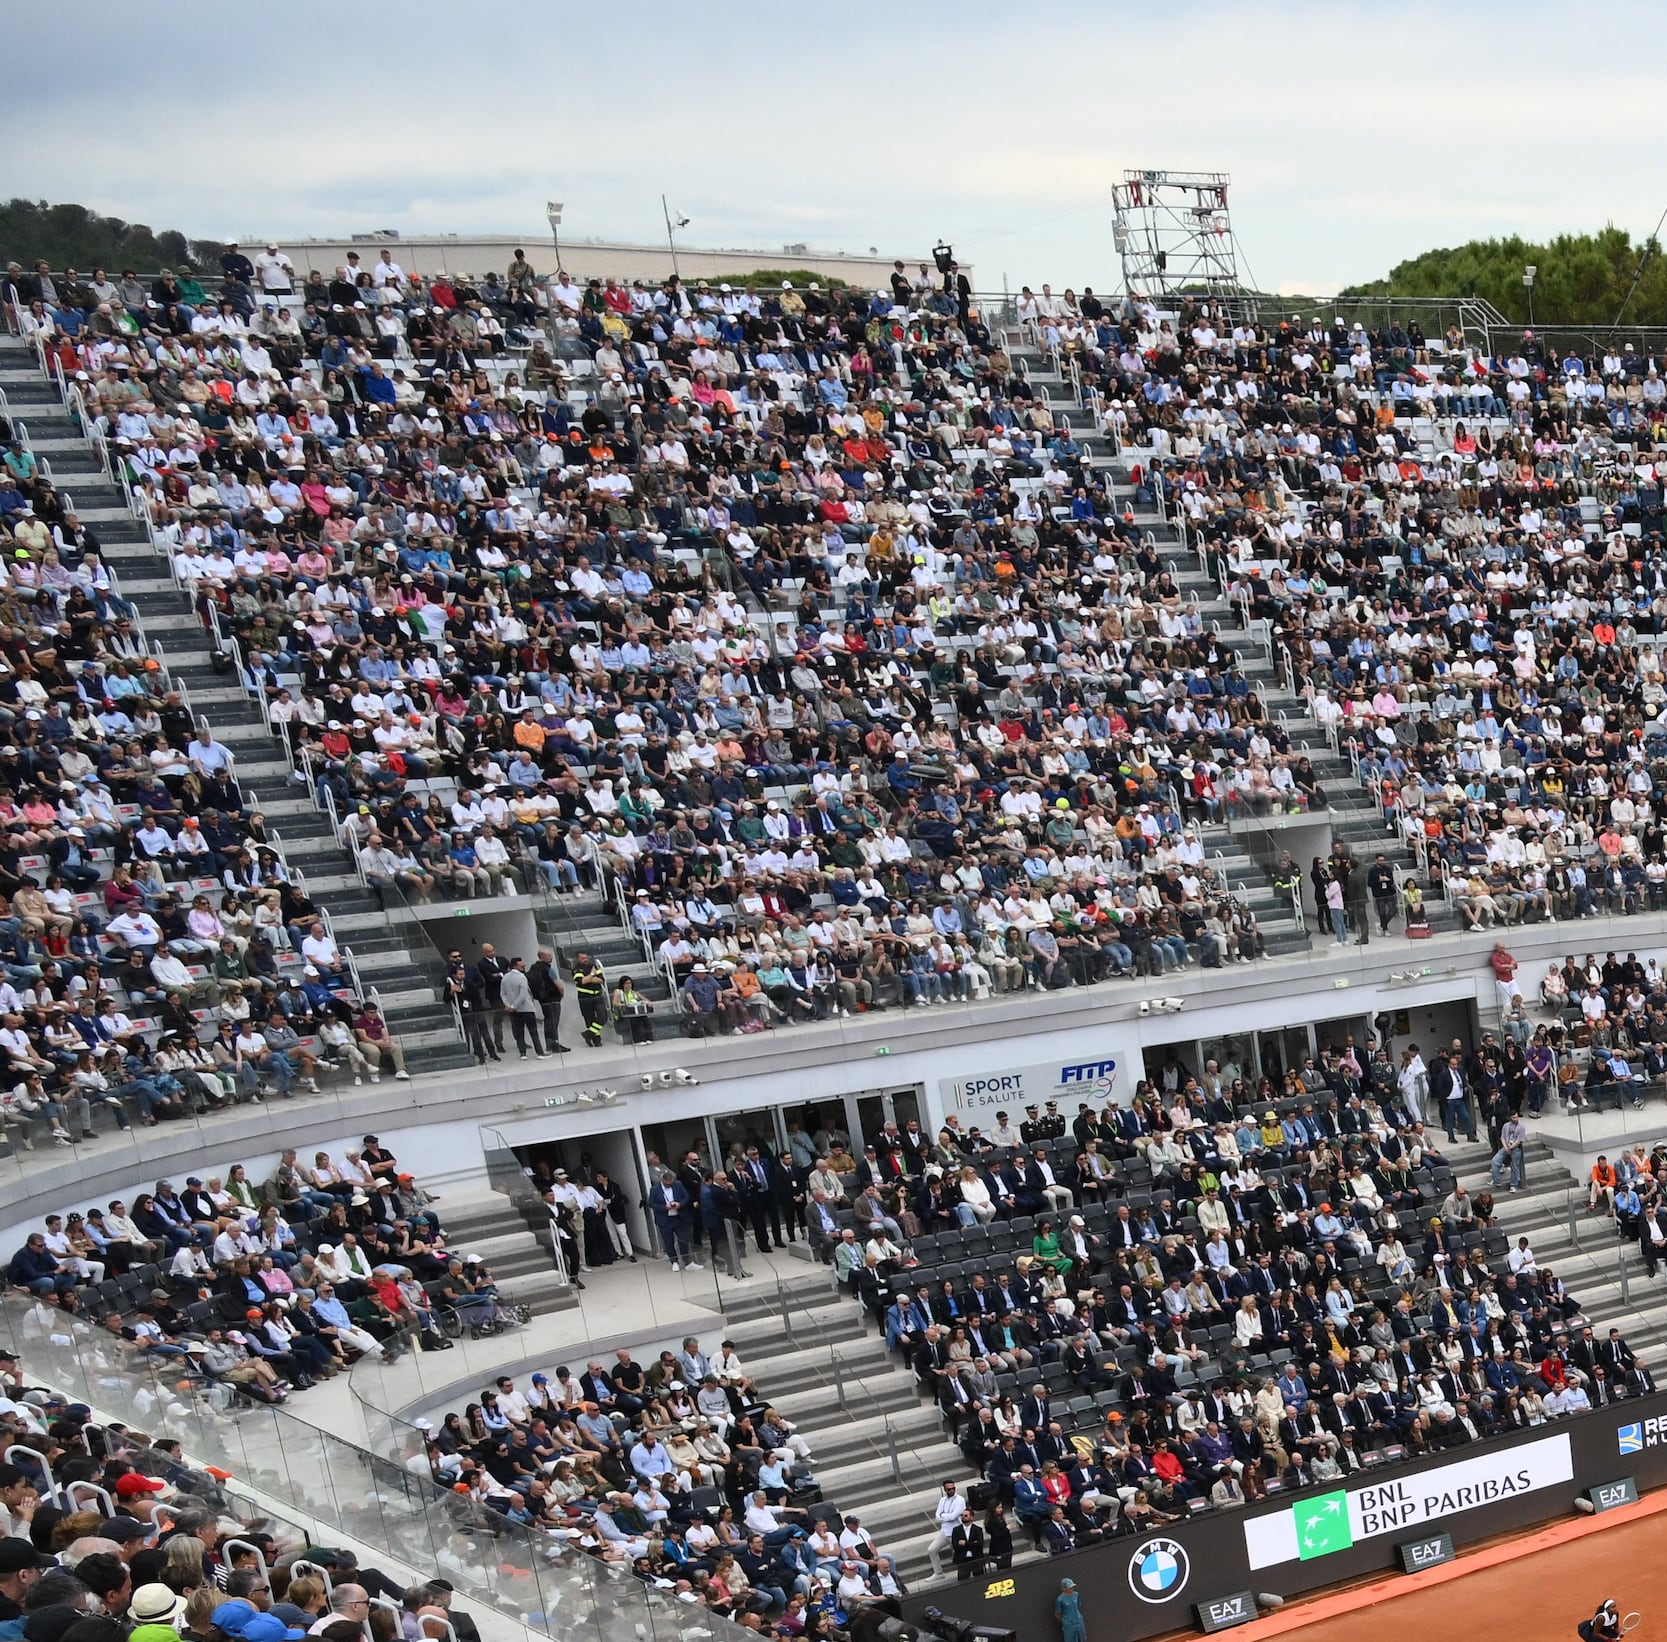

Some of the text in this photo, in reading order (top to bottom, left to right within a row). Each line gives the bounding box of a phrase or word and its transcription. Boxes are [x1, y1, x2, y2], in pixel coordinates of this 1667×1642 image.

[1061, 1060, 1116, 1084] FITP
[965, 1075, 1023, 1096] SPORT
[967, 1090, 1026, 1108] E SALUTE
[1359, 1482, 1412, 1512] BNL
[1362, 1469, 1532, 1535] BNP PARIBAS
[1599, 1484, 1626, 1505] EA7
[1134, 1542, 1179, 1566] BMW
[1411, 1540, 1442, 1562] EA7
[1209, 1597, 1242, 1620] EA7
